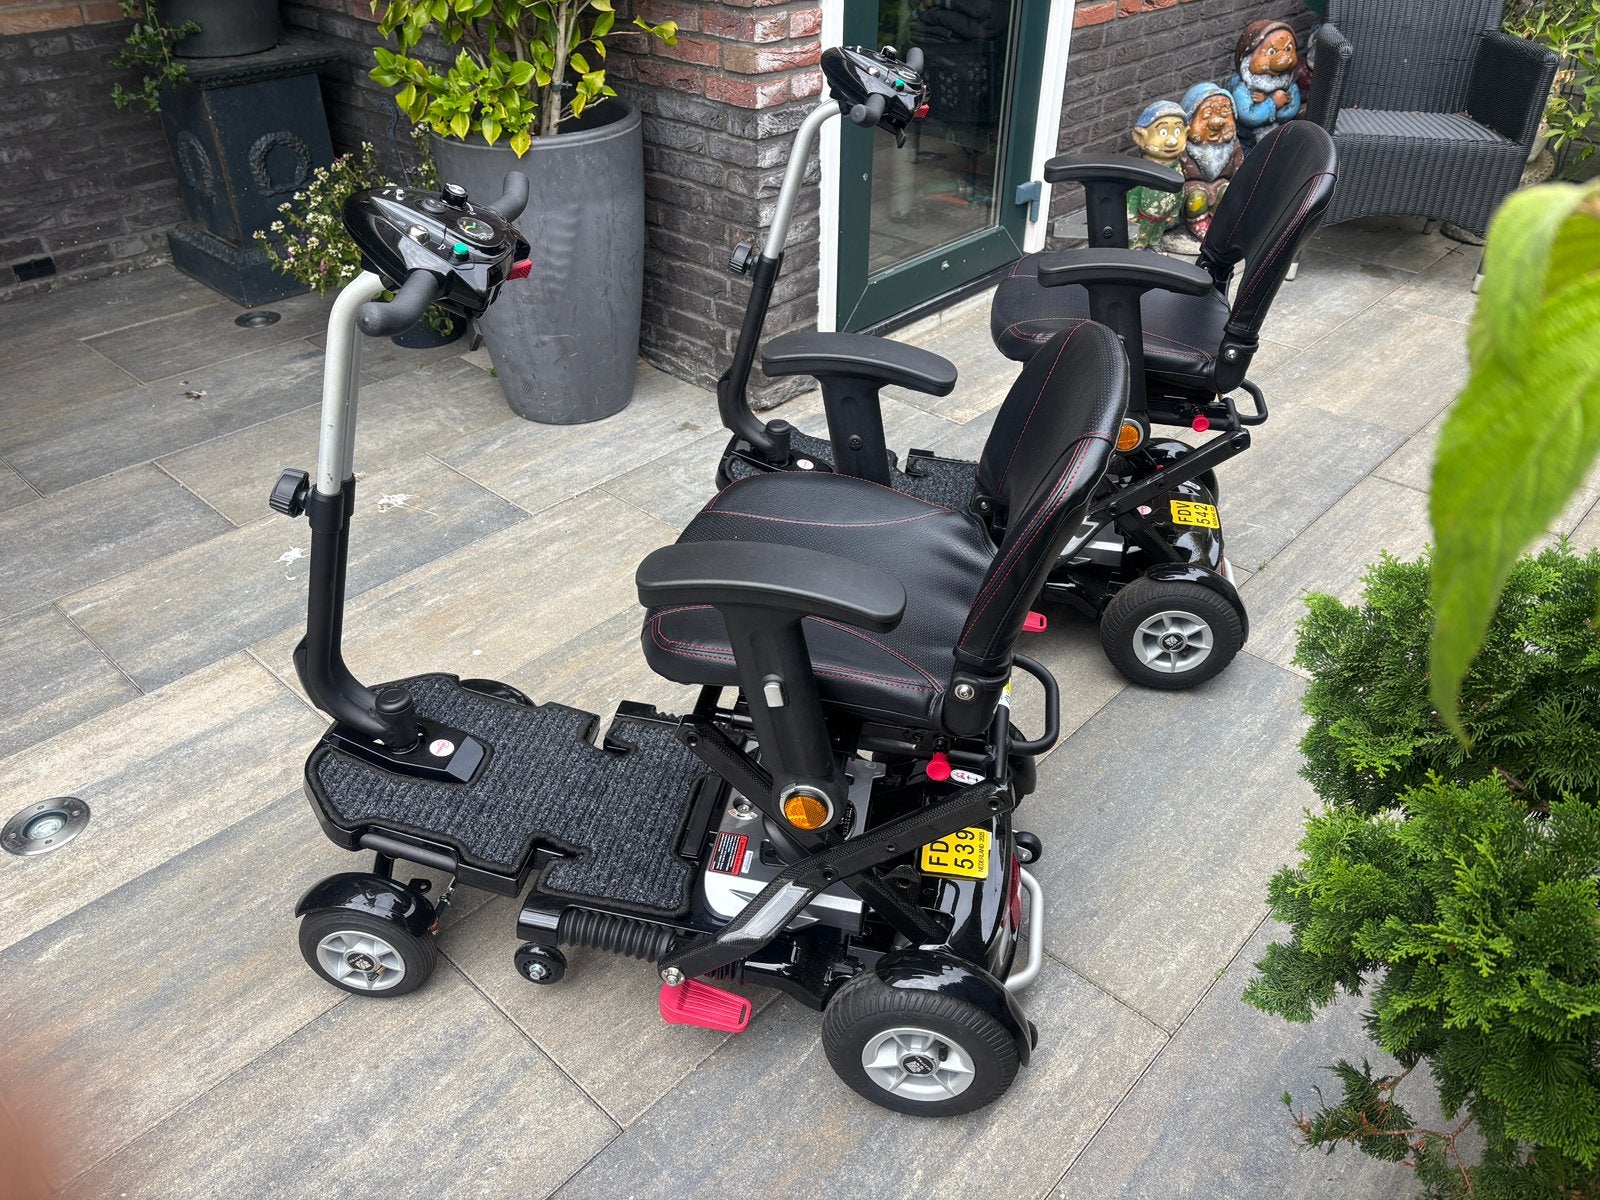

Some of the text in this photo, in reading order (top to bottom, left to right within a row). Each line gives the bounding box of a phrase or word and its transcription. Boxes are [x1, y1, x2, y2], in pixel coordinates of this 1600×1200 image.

[1176, 502, 1193, 523] FDV
[1194, 504, 1211, 525] 542
[928, 841, 949, 867] FD
[954, 829, 975, 870] 539
